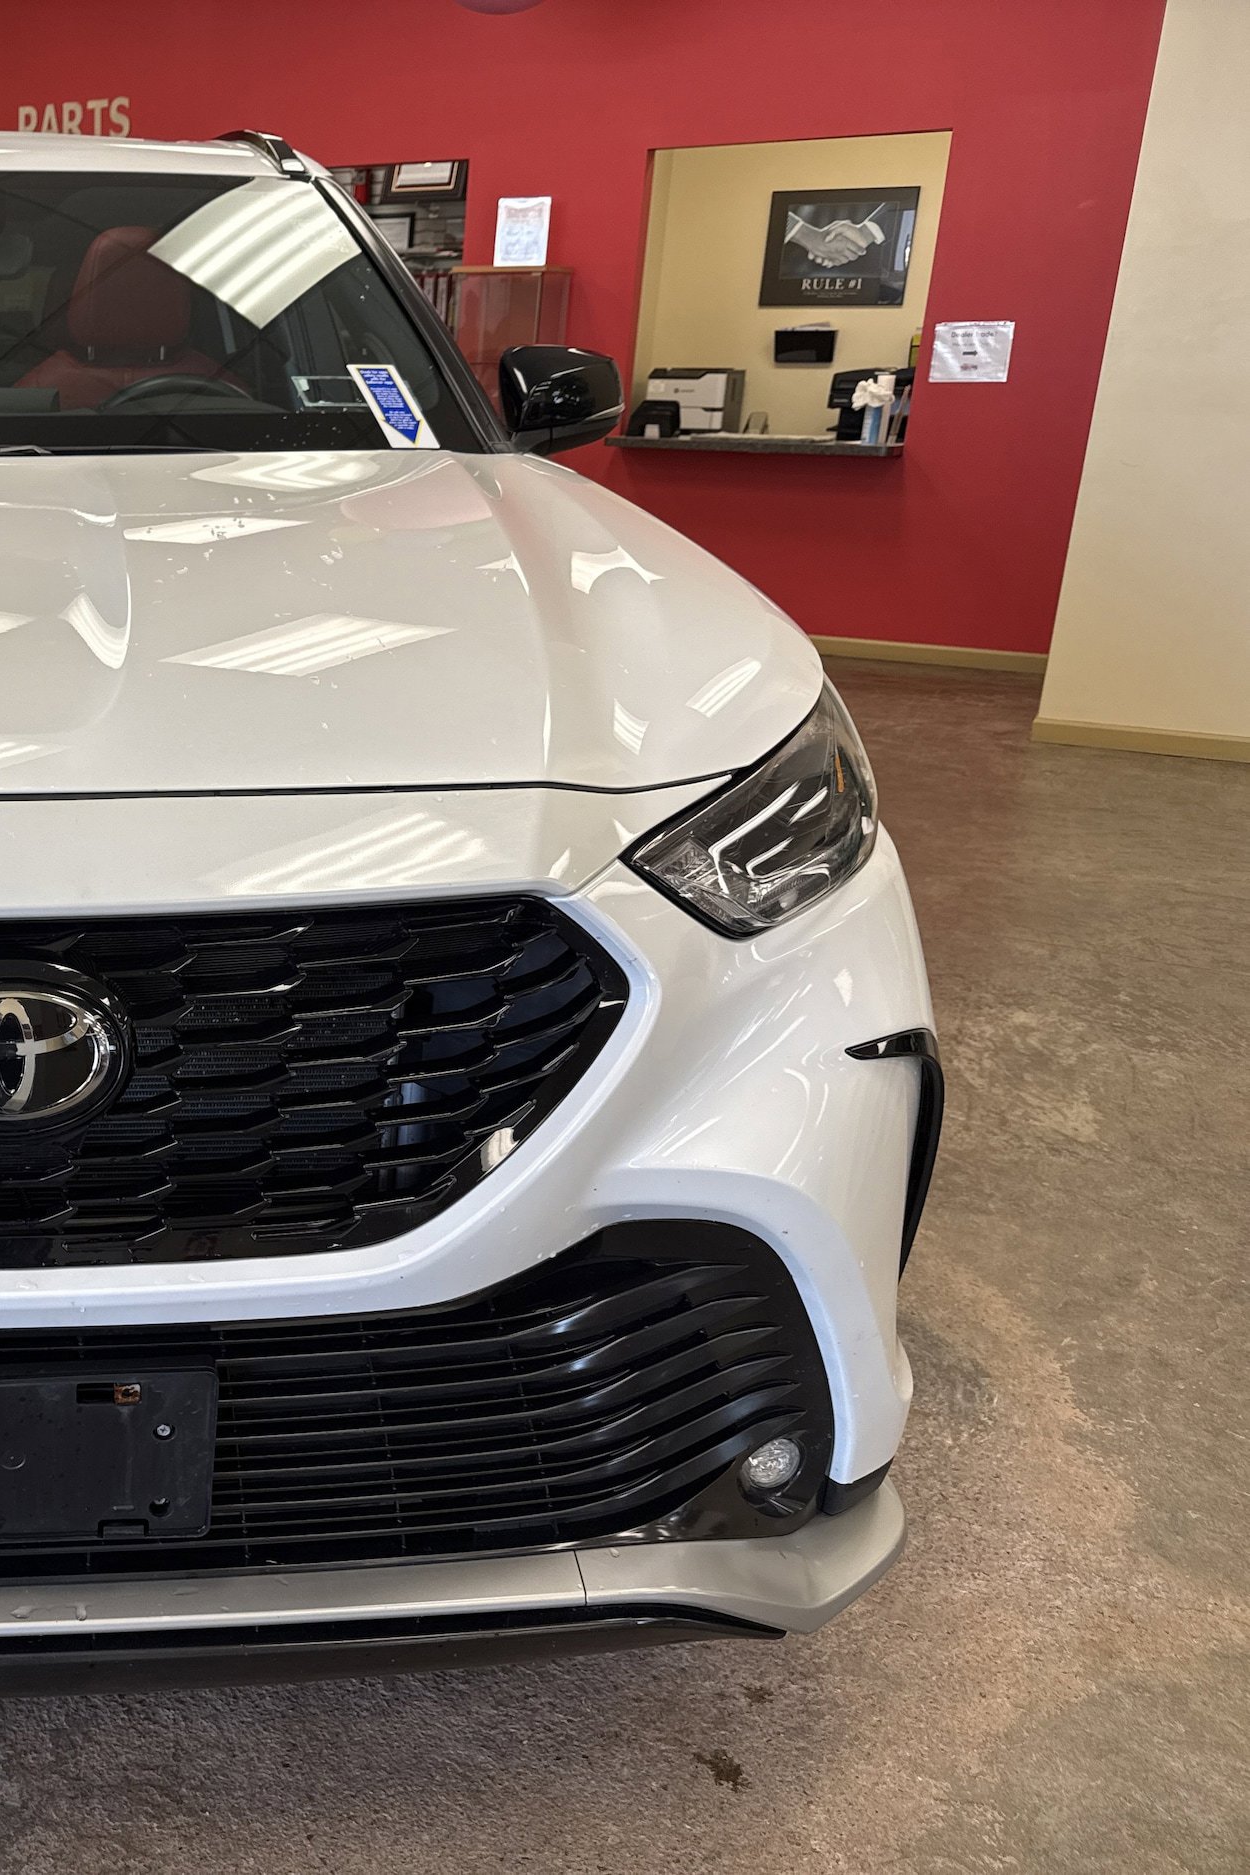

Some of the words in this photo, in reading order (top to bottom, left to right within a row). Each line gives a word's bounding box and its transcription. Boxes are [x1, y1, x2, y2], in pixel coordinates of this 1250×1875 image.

[18, 96, 130, 138] PARTS
[801, 278, 845, 291] RULE
[848, 278, 862, 290] #1
